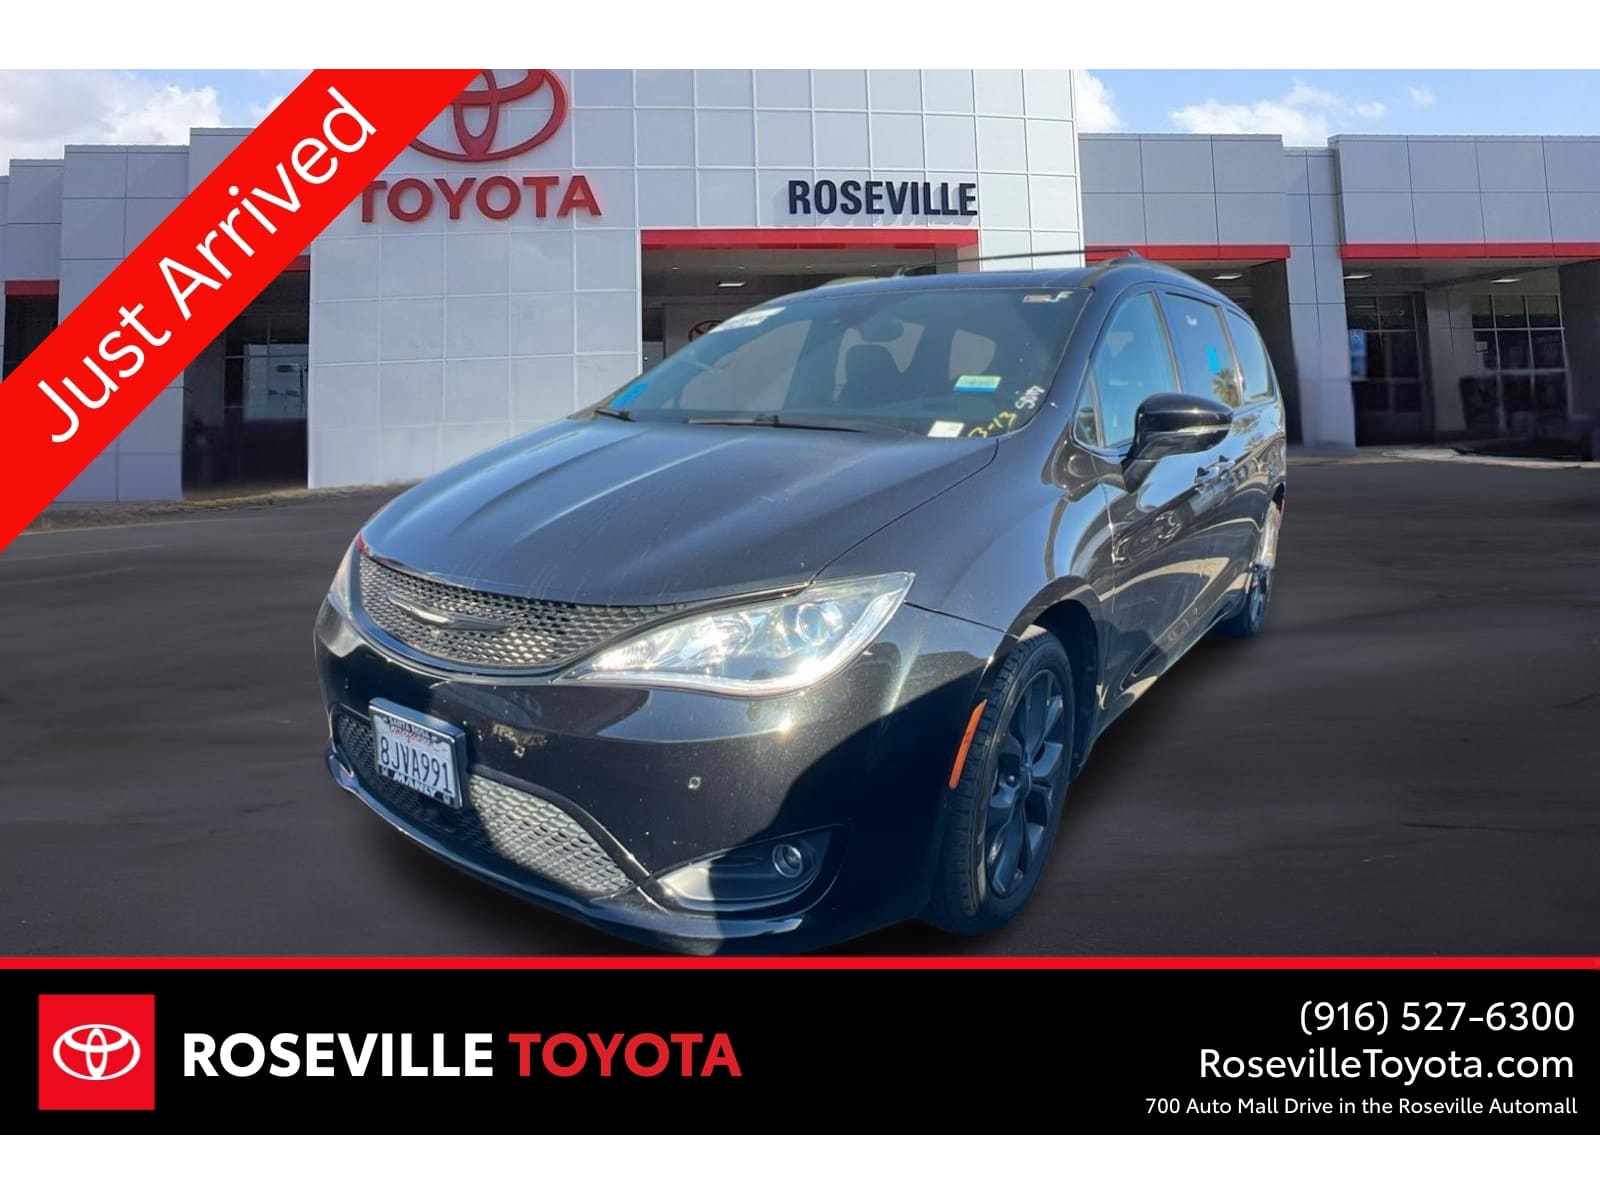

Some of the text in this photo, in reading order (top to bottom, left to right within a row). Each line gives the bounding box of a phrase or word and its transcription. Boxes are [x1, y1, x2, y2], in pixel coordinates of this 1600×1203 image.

[361, 175, 603, 223] TOYOTA
[788, 179, 979, 216] ROSEVILLE
[380, 736, 453, 794] 8JVA991
